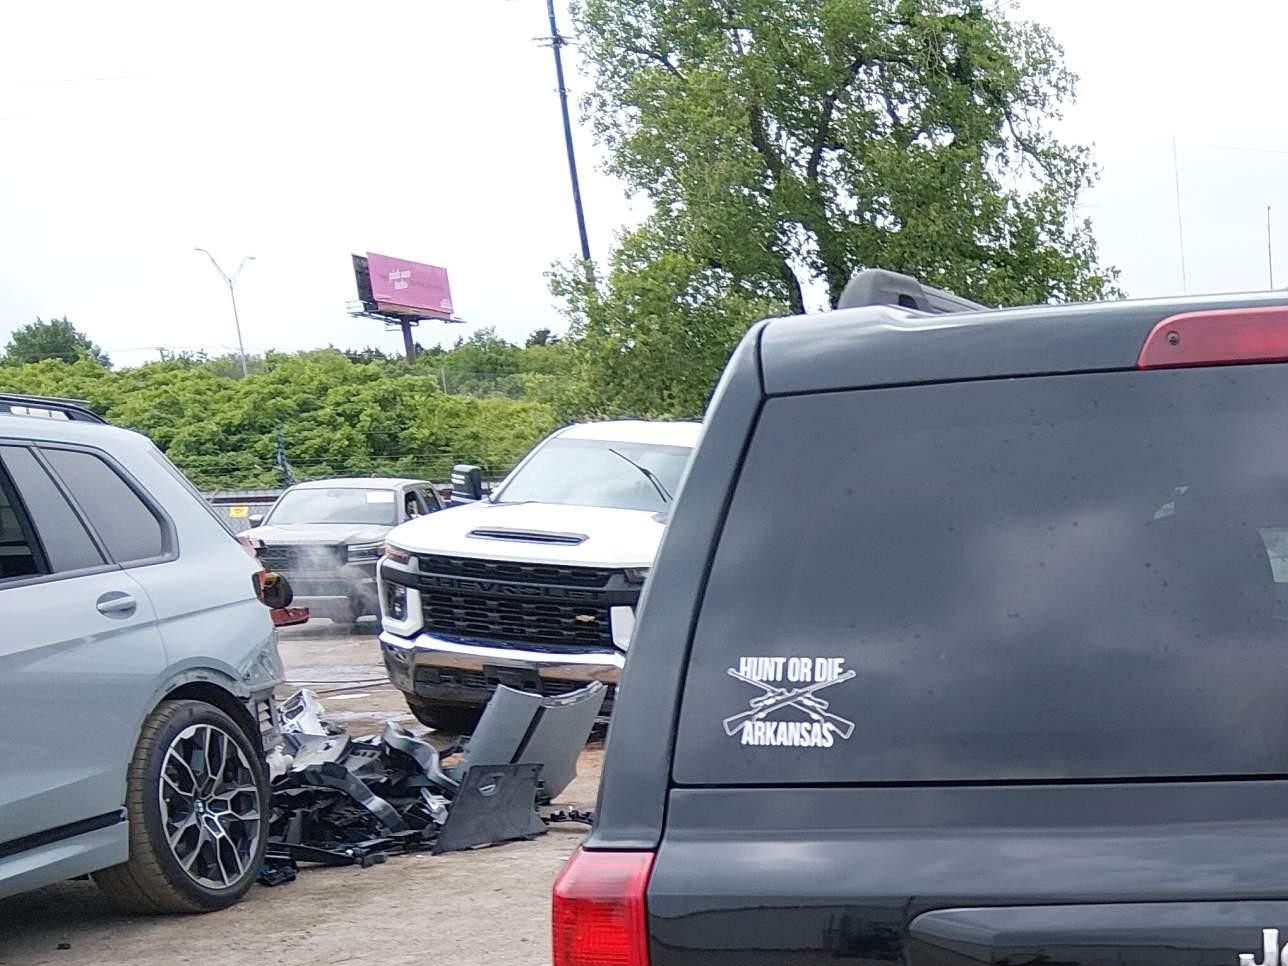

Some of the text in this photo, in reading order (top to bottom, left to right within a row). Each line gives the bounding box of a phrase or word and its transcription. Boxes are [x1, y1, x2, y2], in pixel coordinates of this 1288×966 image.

[418, 576, 604, 601] CHEVROLET
[739, 656, 845, 682] HUNT OR DIE
[741, 720, 834, 747] ARKANSAS
